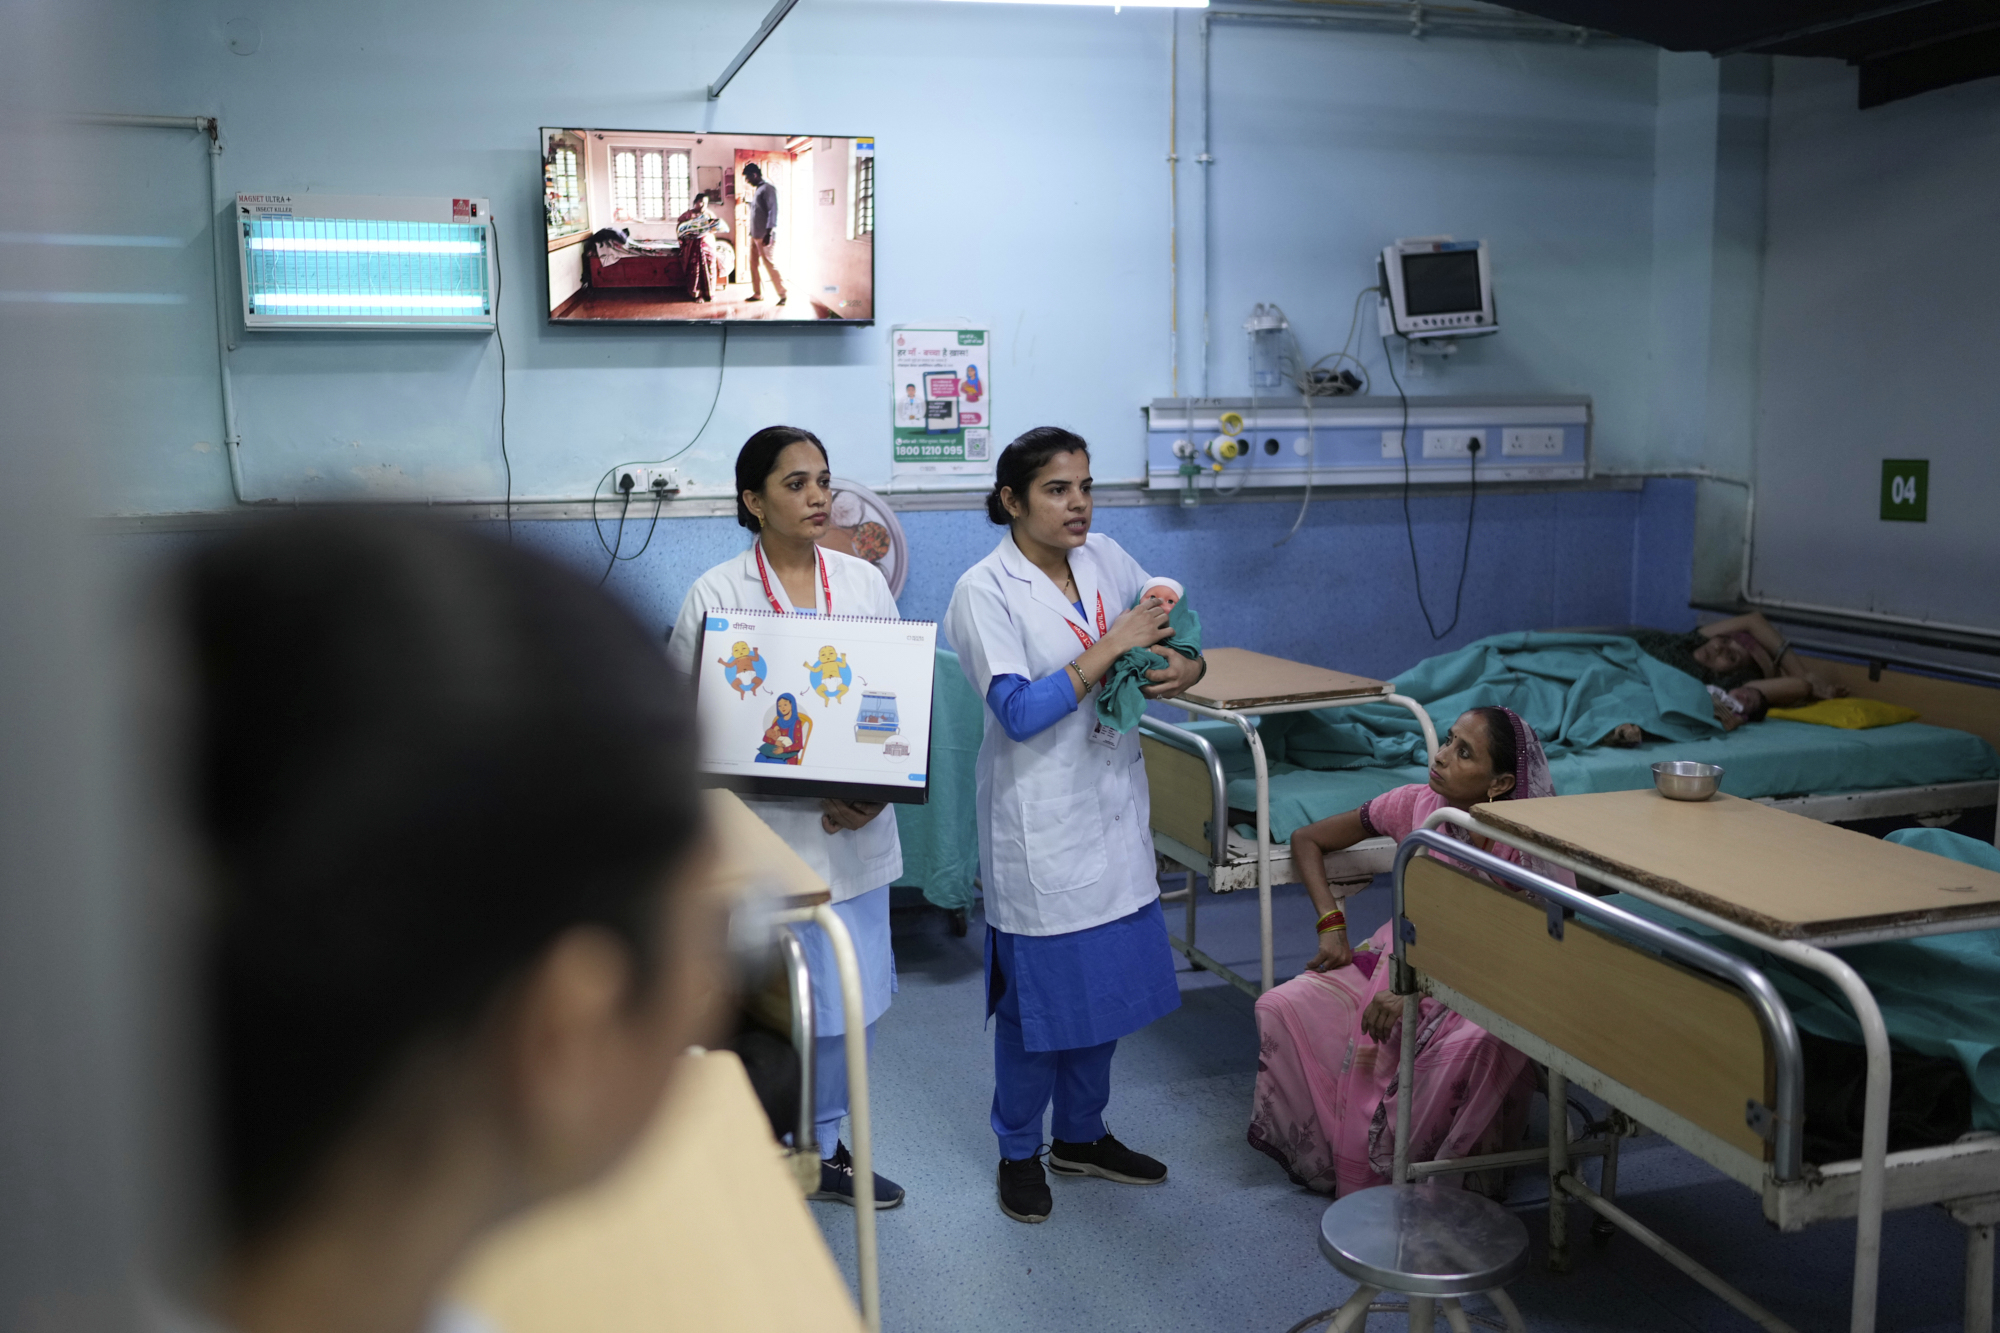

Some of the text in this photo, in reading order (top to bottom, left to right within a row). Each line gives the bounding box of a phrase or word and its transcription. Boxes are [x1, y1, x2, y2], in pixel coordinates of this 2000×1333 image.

[238, 195, 264, 203] MAGNET
[265, 195, 285, 203] ULTRA
[896, 446, 963, 455] 1800 1210 095
[1892, 475, 1916, 504] 04
